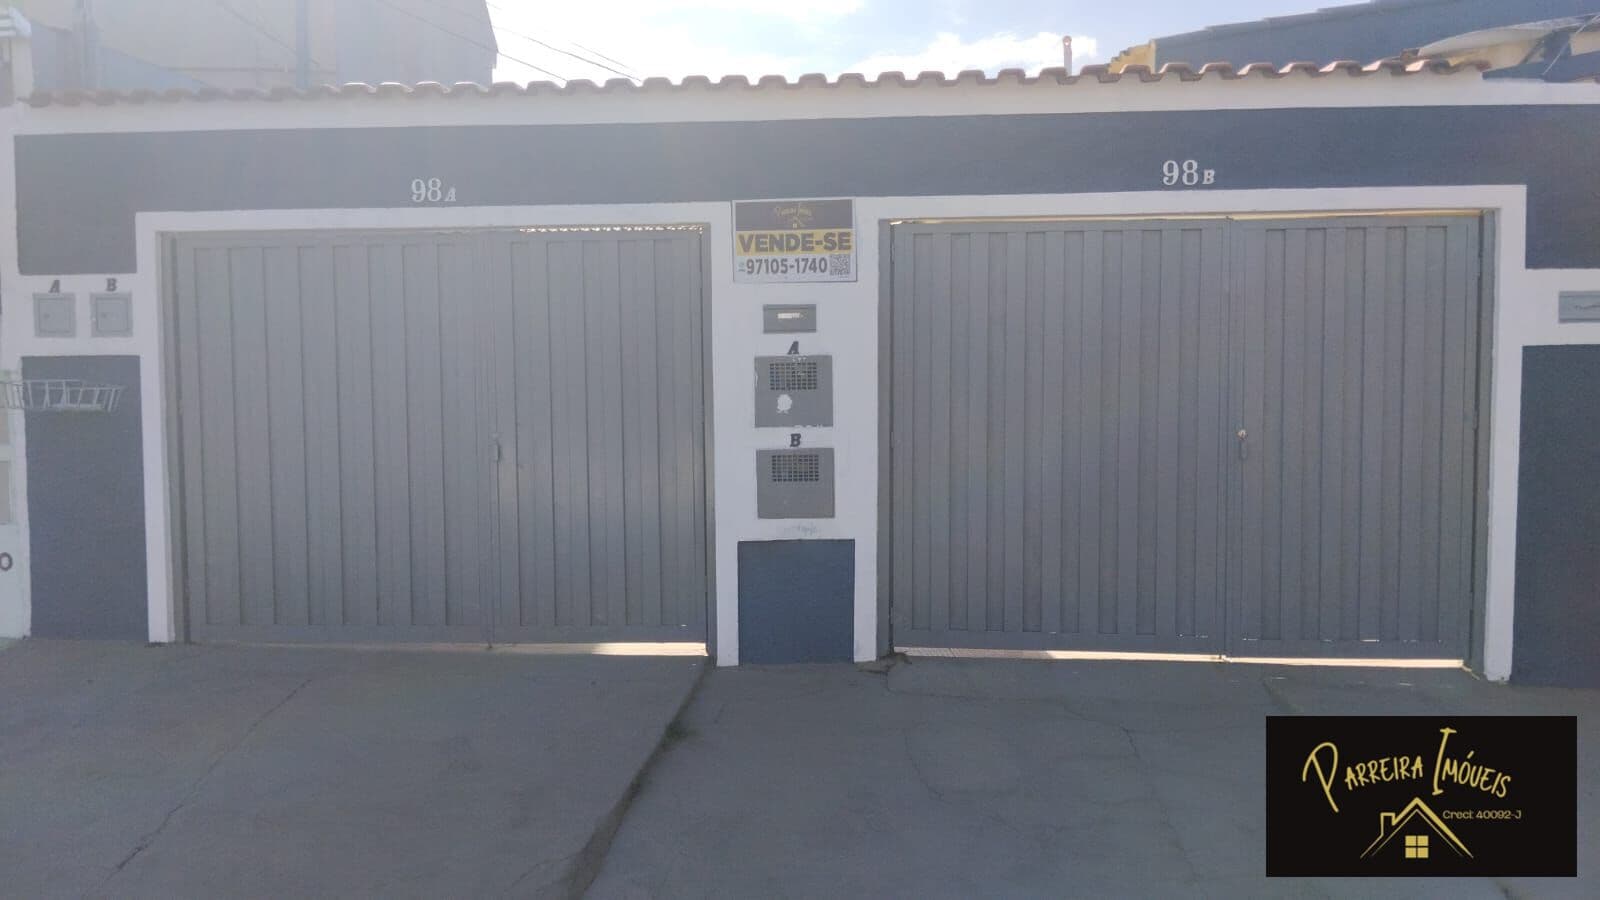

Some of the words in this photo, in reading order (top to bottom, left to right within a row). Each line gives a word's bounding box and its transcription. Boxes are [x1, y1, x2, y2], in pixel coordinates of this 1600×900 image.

[738, 231, 852, 253] VENDE-SE
[746, 257, 828, 275] 97105-1740
[48, 279, 61, 294] A
[106, 277, 118, 292] B
[787, 341, 800, 355] A
[790, 433, 802, 448] B
